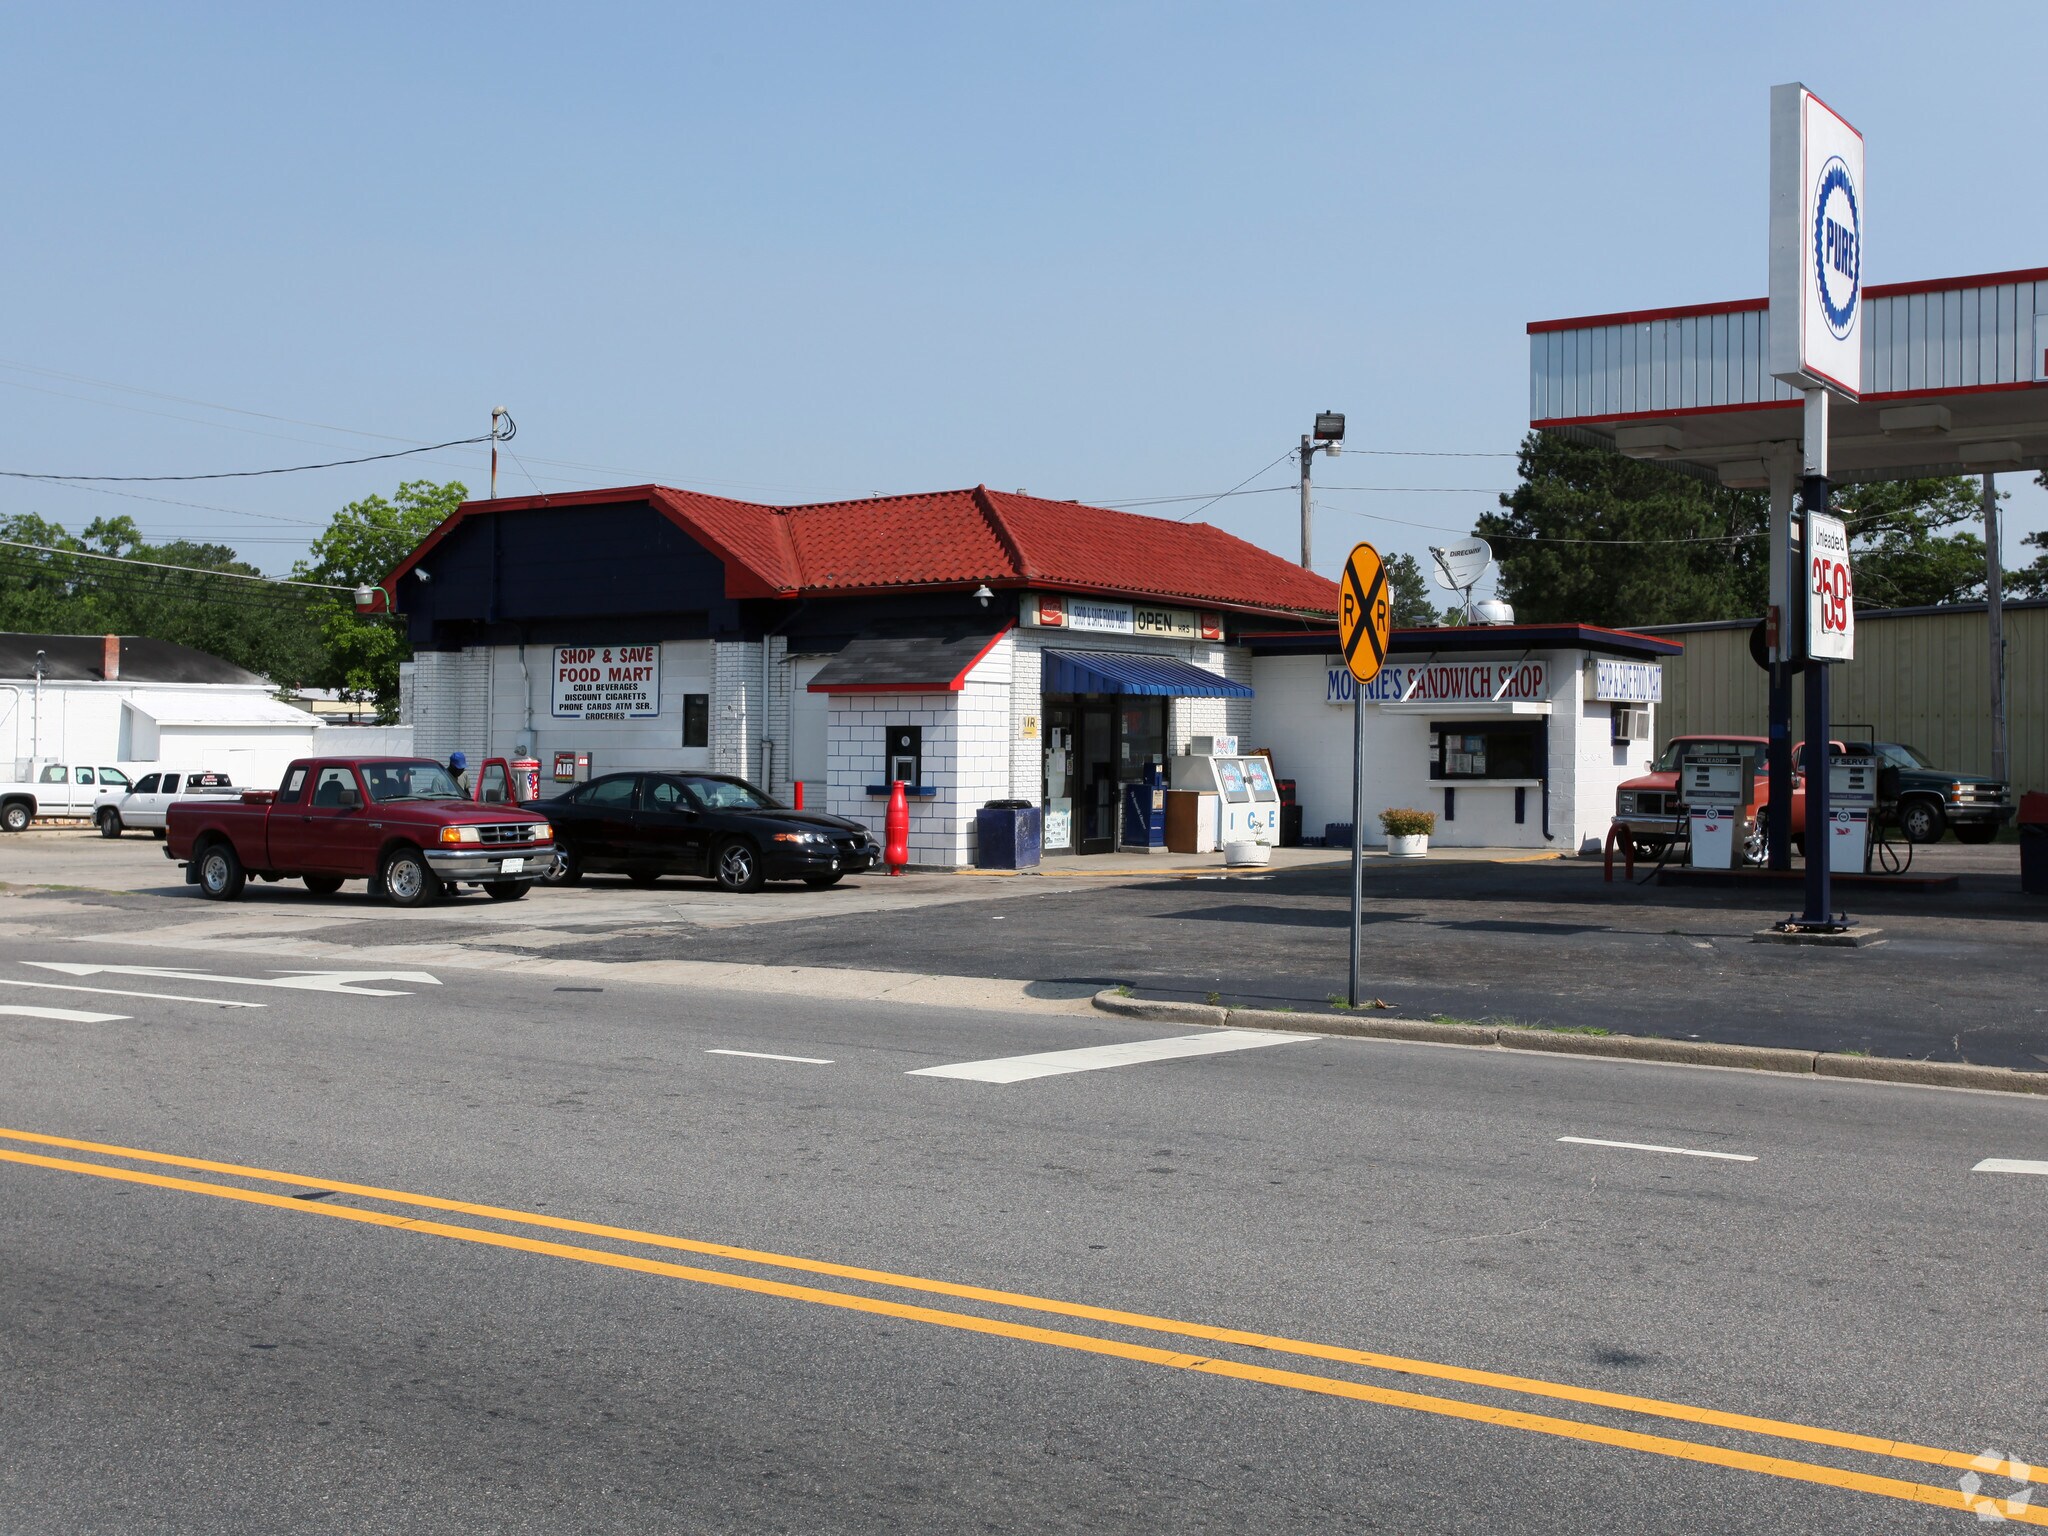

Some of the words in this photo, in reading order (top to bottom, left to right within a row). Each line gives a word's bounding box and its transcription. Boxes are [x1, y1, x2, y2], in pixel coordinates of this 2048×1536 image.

[1826, 217, 1854, 279] PURE
[1815, 525, 1845, 551] Unleaded
[1138, 611, 1172, 632] OPEN
[1177, 624, 1190, 634] HRS
[560, 648, 595, 664] SHOP
[602, 649, 613, 663] &
[619, 647, 654, 663] SAVE
[560, 668, 601, 682] FOOD
[608, 667, 653, 682] MART
[1407, 666, 1492, 699] SANDWICH
[1498, 665, 1543, 698] SHOP
[573, 684, 593, 692] COLD
[596, 683, 638, 691] BEVERAGES
[605, 692, 647, 701] CIGARETTS
[559, 703, 583, 711] PHONE
[587, 702, 612, 710] CARDS
[635, 702, 652, 710] SER.
[556, 764, 573, 775] AIR
[1230, 811, 1275, 830] ICE
